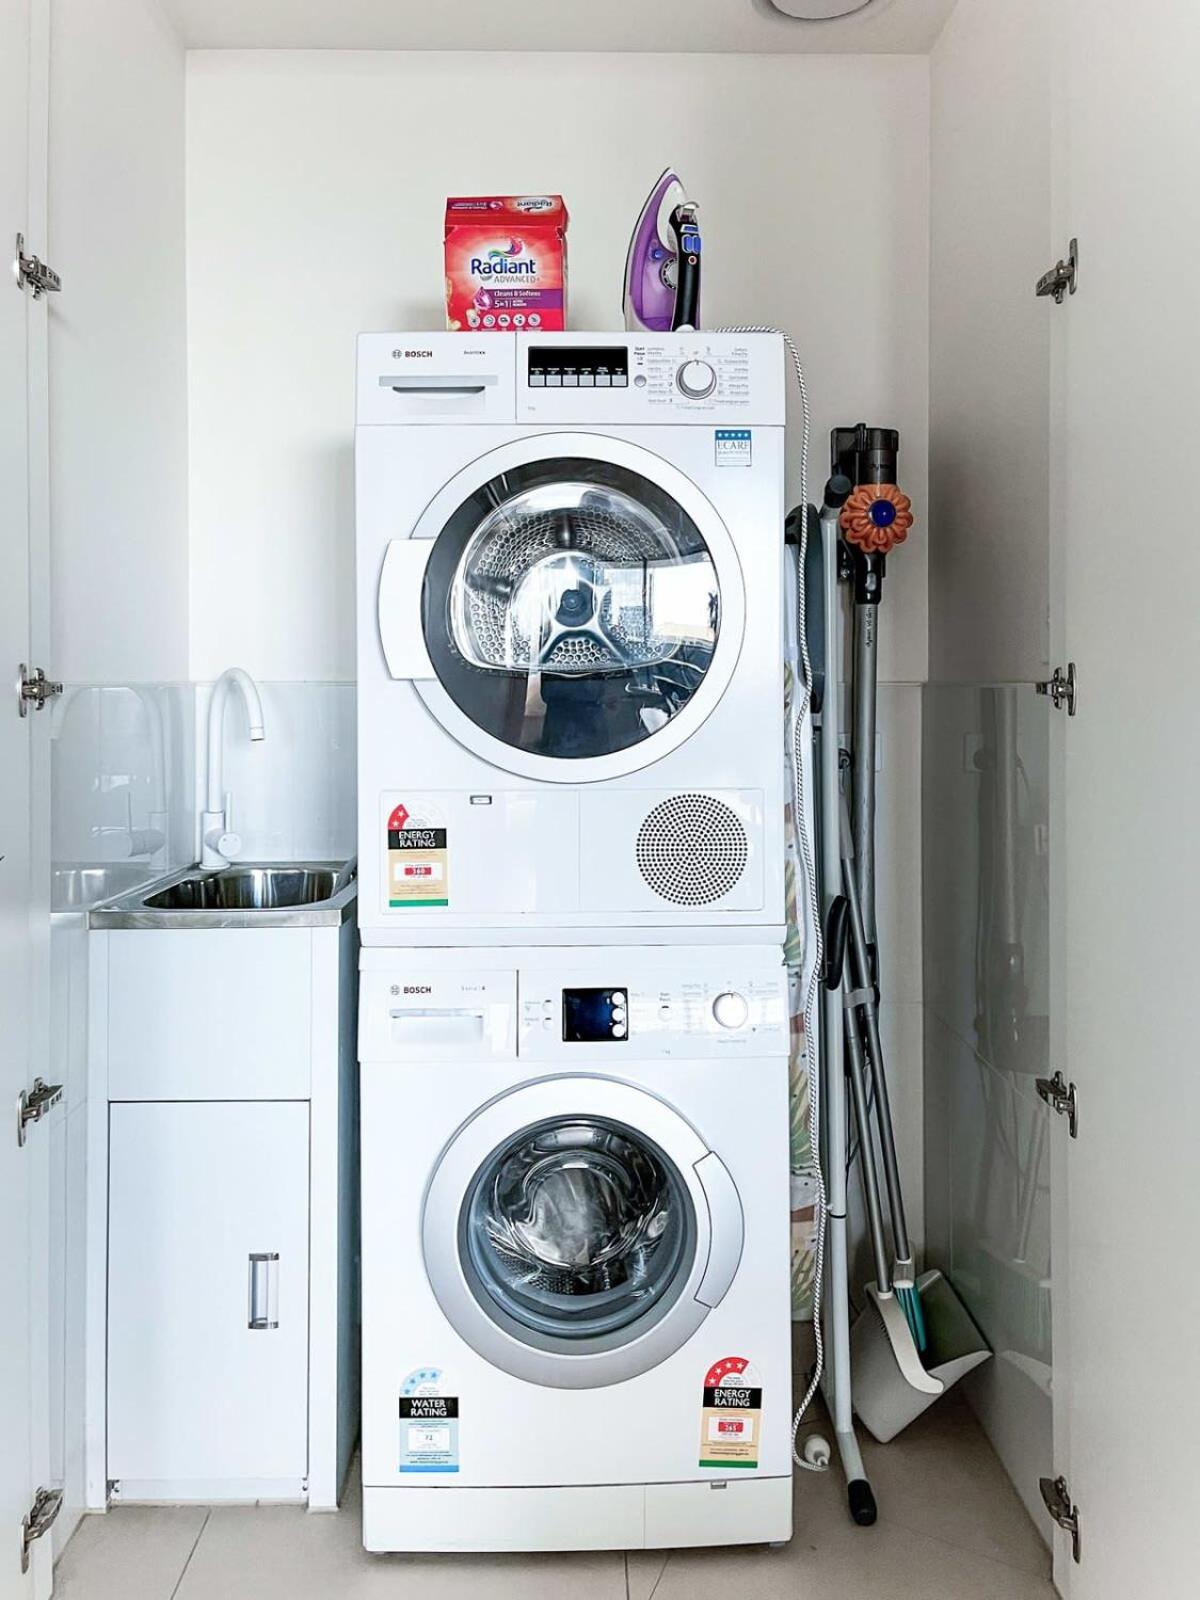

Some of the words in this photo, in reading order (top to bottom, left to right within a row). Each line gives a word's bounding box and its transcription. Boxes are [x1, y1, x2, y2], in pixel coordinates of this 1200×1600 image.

[471, 258, 536, 275] Radiant
[404, 350, 433, 358] BOSCH
[398, 831, 436, 839] ENERGY
[399, 840, 436, 848] RATING
[403, 986, 432, 994] BOSCH
[714, 1389, 752, 1398] ENERGY
[411, 1399, 446, 1408] WATER
[714, 1398, 750, 1407] RATING
[410, 1408, 447, 1416] RATING
